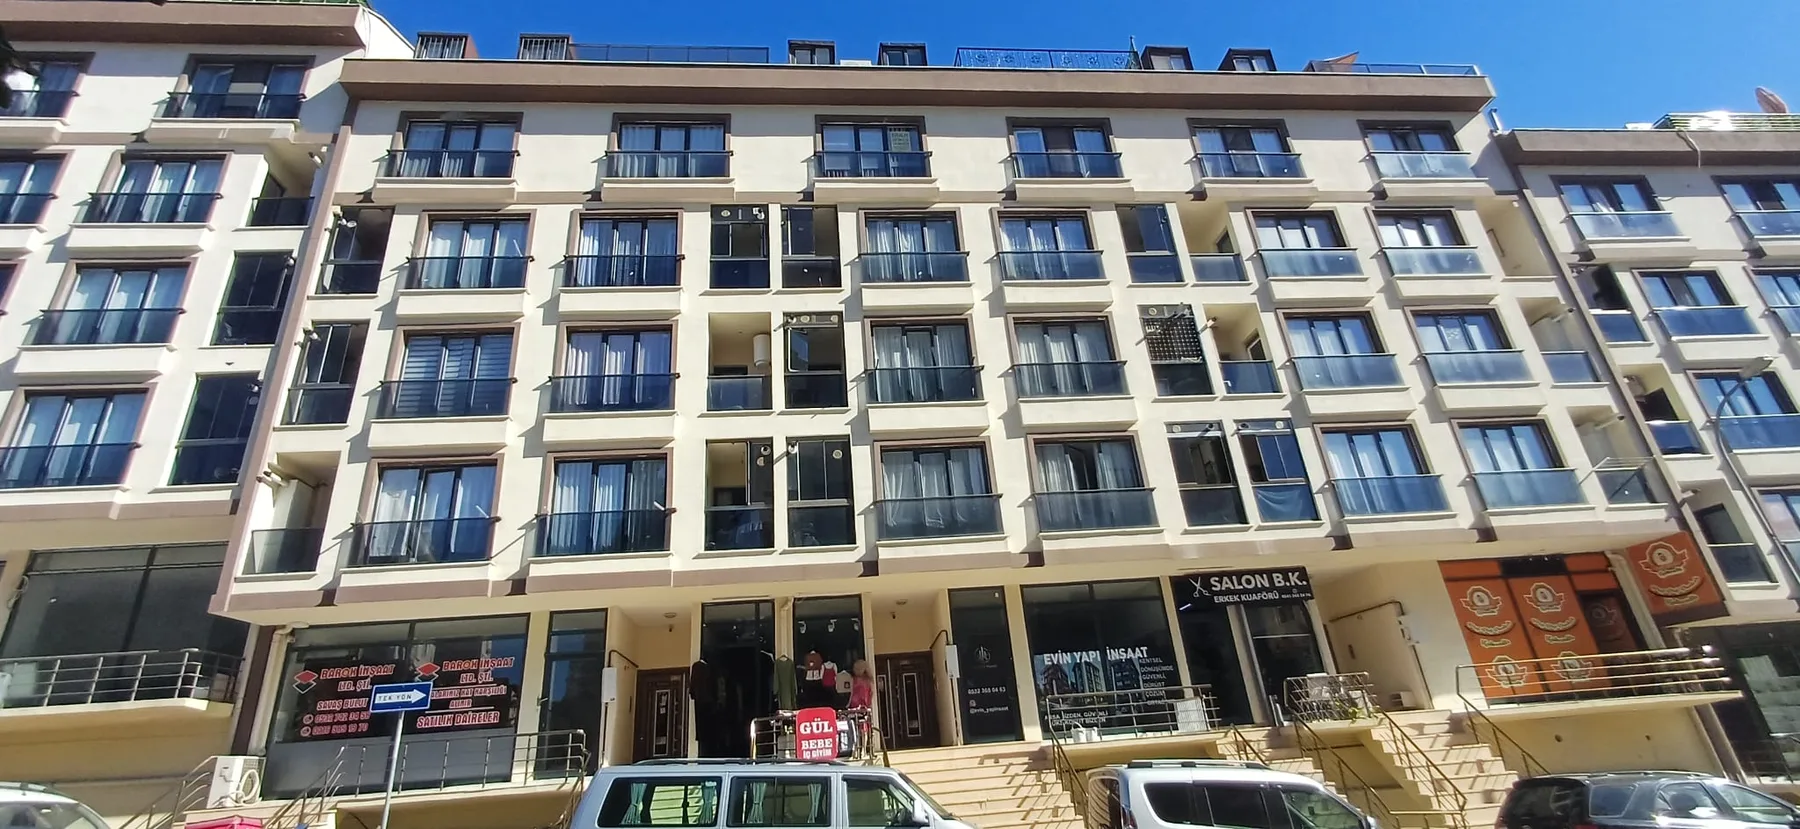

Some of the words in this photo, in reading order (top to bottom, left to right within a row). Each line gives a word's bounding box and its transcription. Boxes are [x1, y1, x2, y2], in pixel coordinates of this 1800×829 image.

[1210, 573, 1270, 591] SALON
[1272, 571, 1308, 587] B.K.
[1213, 594, 1240, 603] ERKEK
[1241, 590, 1280, 602] KUAFÖRÜ
[1043, 650, 1071, 665] EVİN
[1073, 650, 1101, 663] YAPI
[1106, 646, 1148, 662] İNŞAAT
[320, 666, 358, 679] BAROK
[358, 664, 396, 678] İNŞAAT
[442, 659, 479, 672] BAROK
[480, 656, 515, 671] İNŞAAT
[337, 681, 355, 692] LTD.
[356, 677, 373, 692] ŞTİ.
[460, 672, 477, 684] LTD.
[478, 671, 494, 683] ŞTİ.
[460, 687, 474, 698] KAT
[316, 700, 343, 711] SAVAŞ
[343, 697, 369, 709] BULUT
[416, 714, 454, 728] SATILIK
[454, 711, 500, 726] DAİRELER
[799, 717, 833, 734] GÜL
[801, 738, 832, 750] BEBE
